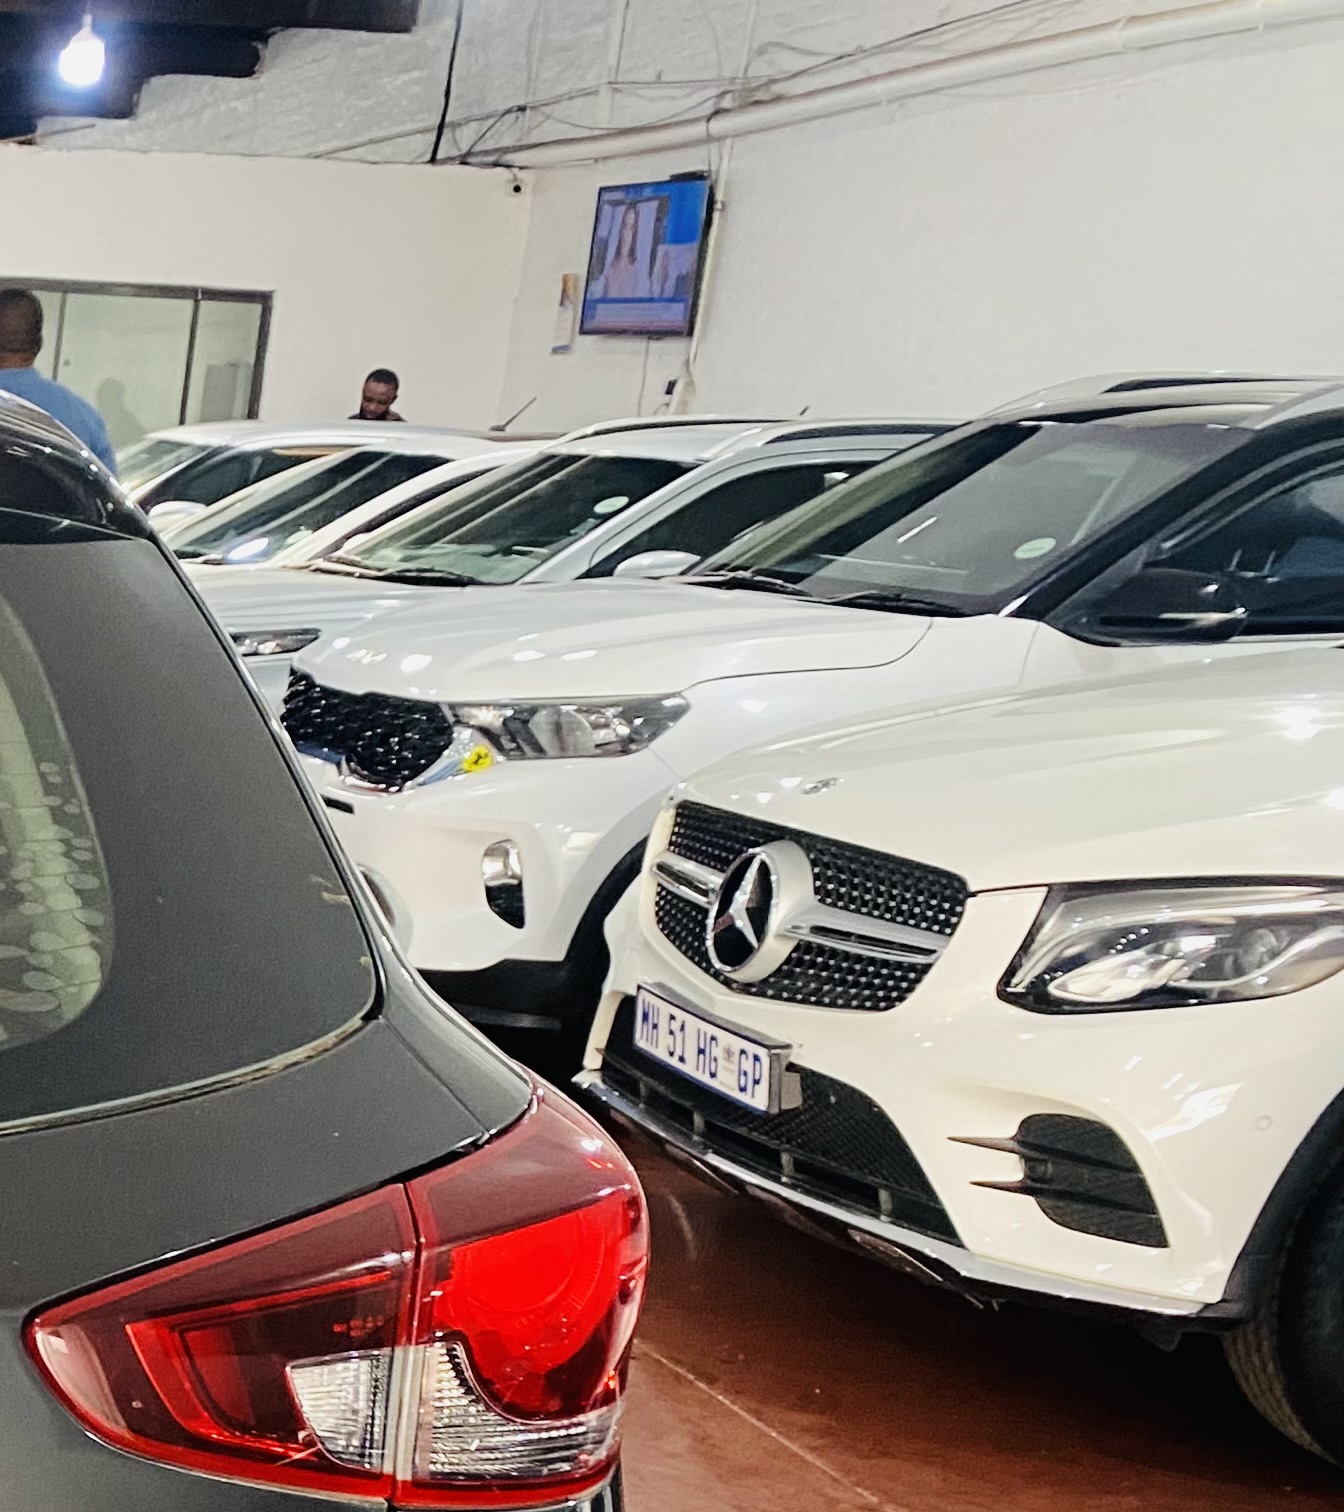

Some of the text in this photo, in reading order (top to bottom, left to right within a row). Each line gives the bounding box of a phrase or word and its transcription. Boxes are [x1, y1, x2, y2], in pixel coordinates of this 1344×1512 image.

[667, 1013, 687, 1065] 51
[695, 1027, 719, 1079] HG
[737, 1047, 763, 1098] GP
